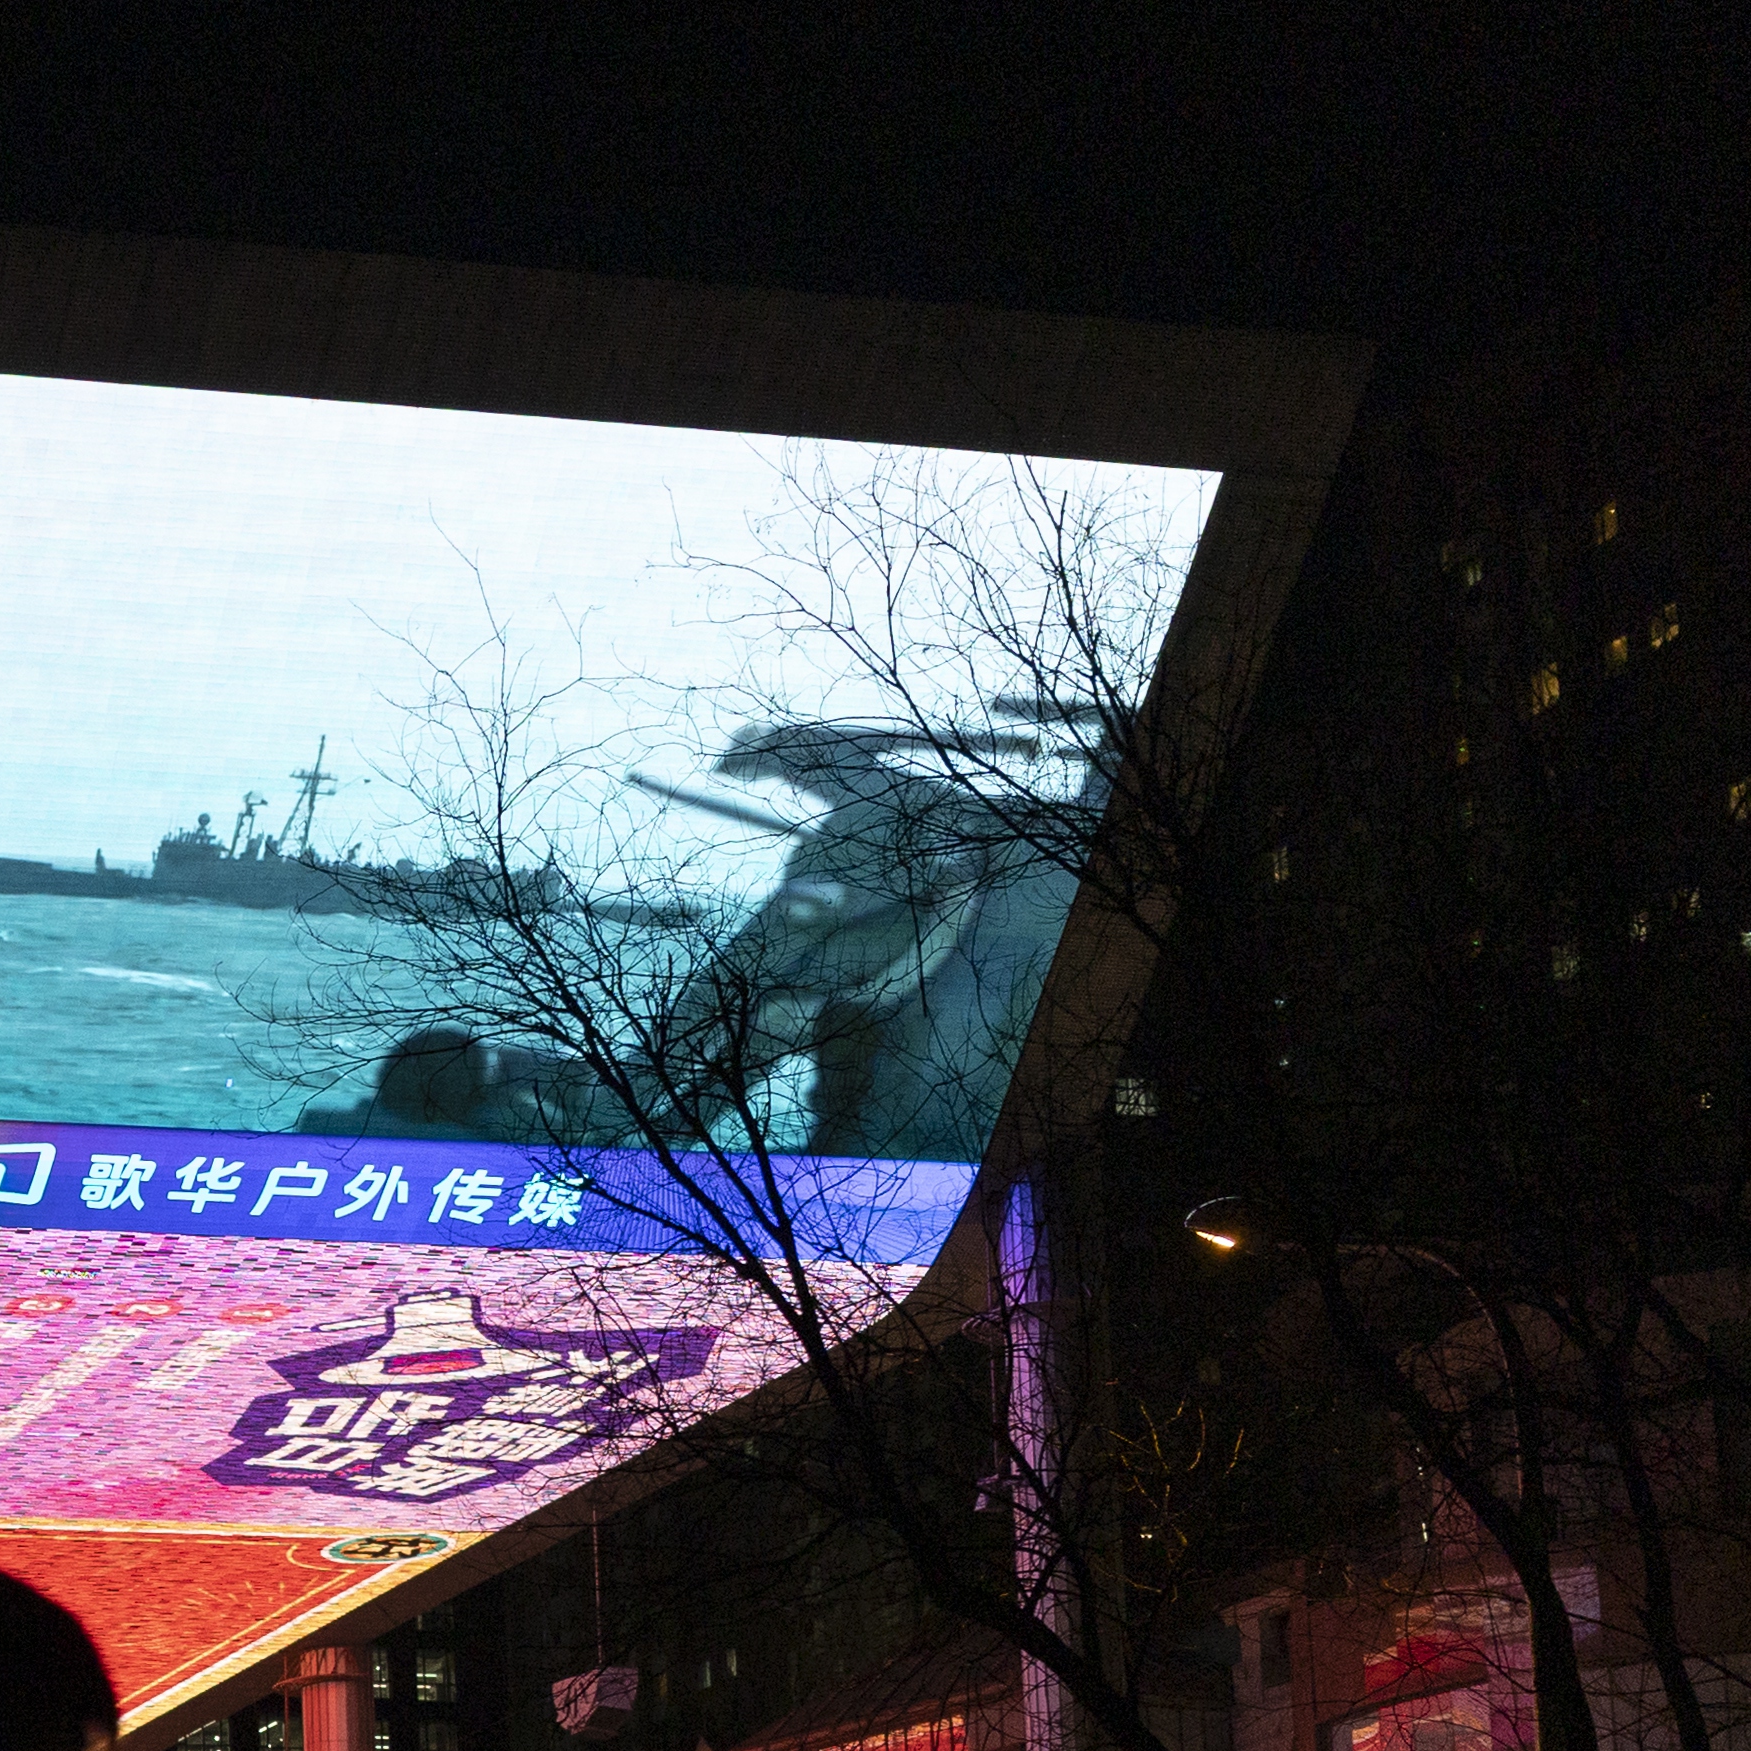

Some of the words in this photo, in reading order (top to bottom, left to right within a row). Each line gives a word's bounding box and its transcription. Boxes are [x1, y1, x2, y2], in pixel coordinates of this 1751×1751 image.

[79, 1151, 590, 1228] 歌华户外传媒
